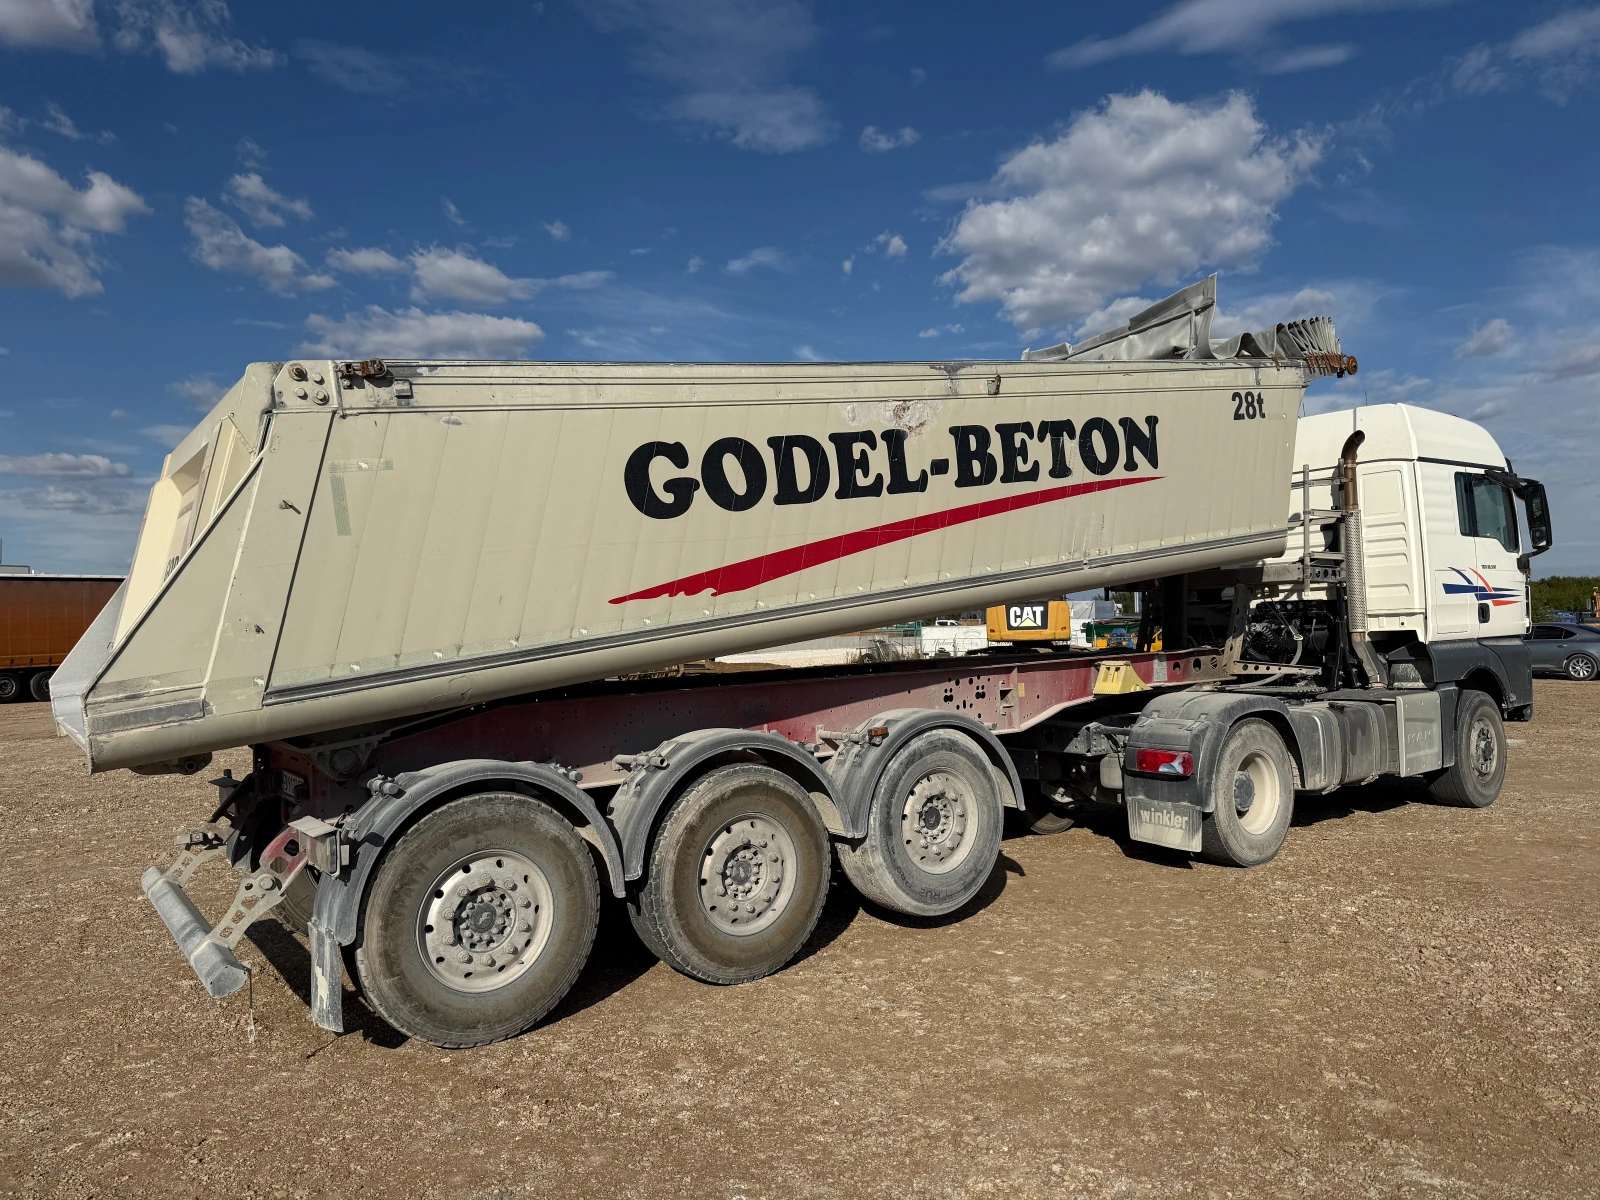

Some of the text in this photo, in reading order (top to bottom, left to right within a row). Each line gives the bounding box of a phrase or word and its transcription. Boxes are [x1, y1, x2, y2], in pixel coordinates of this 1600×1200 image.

[1231, 391, 1266, 420] 28t
[624, 415, 1160, 519] GODEL-BETON
[1009, 606, 1044, 627] CAT
[1140, 807, 1189, 830] winkler
